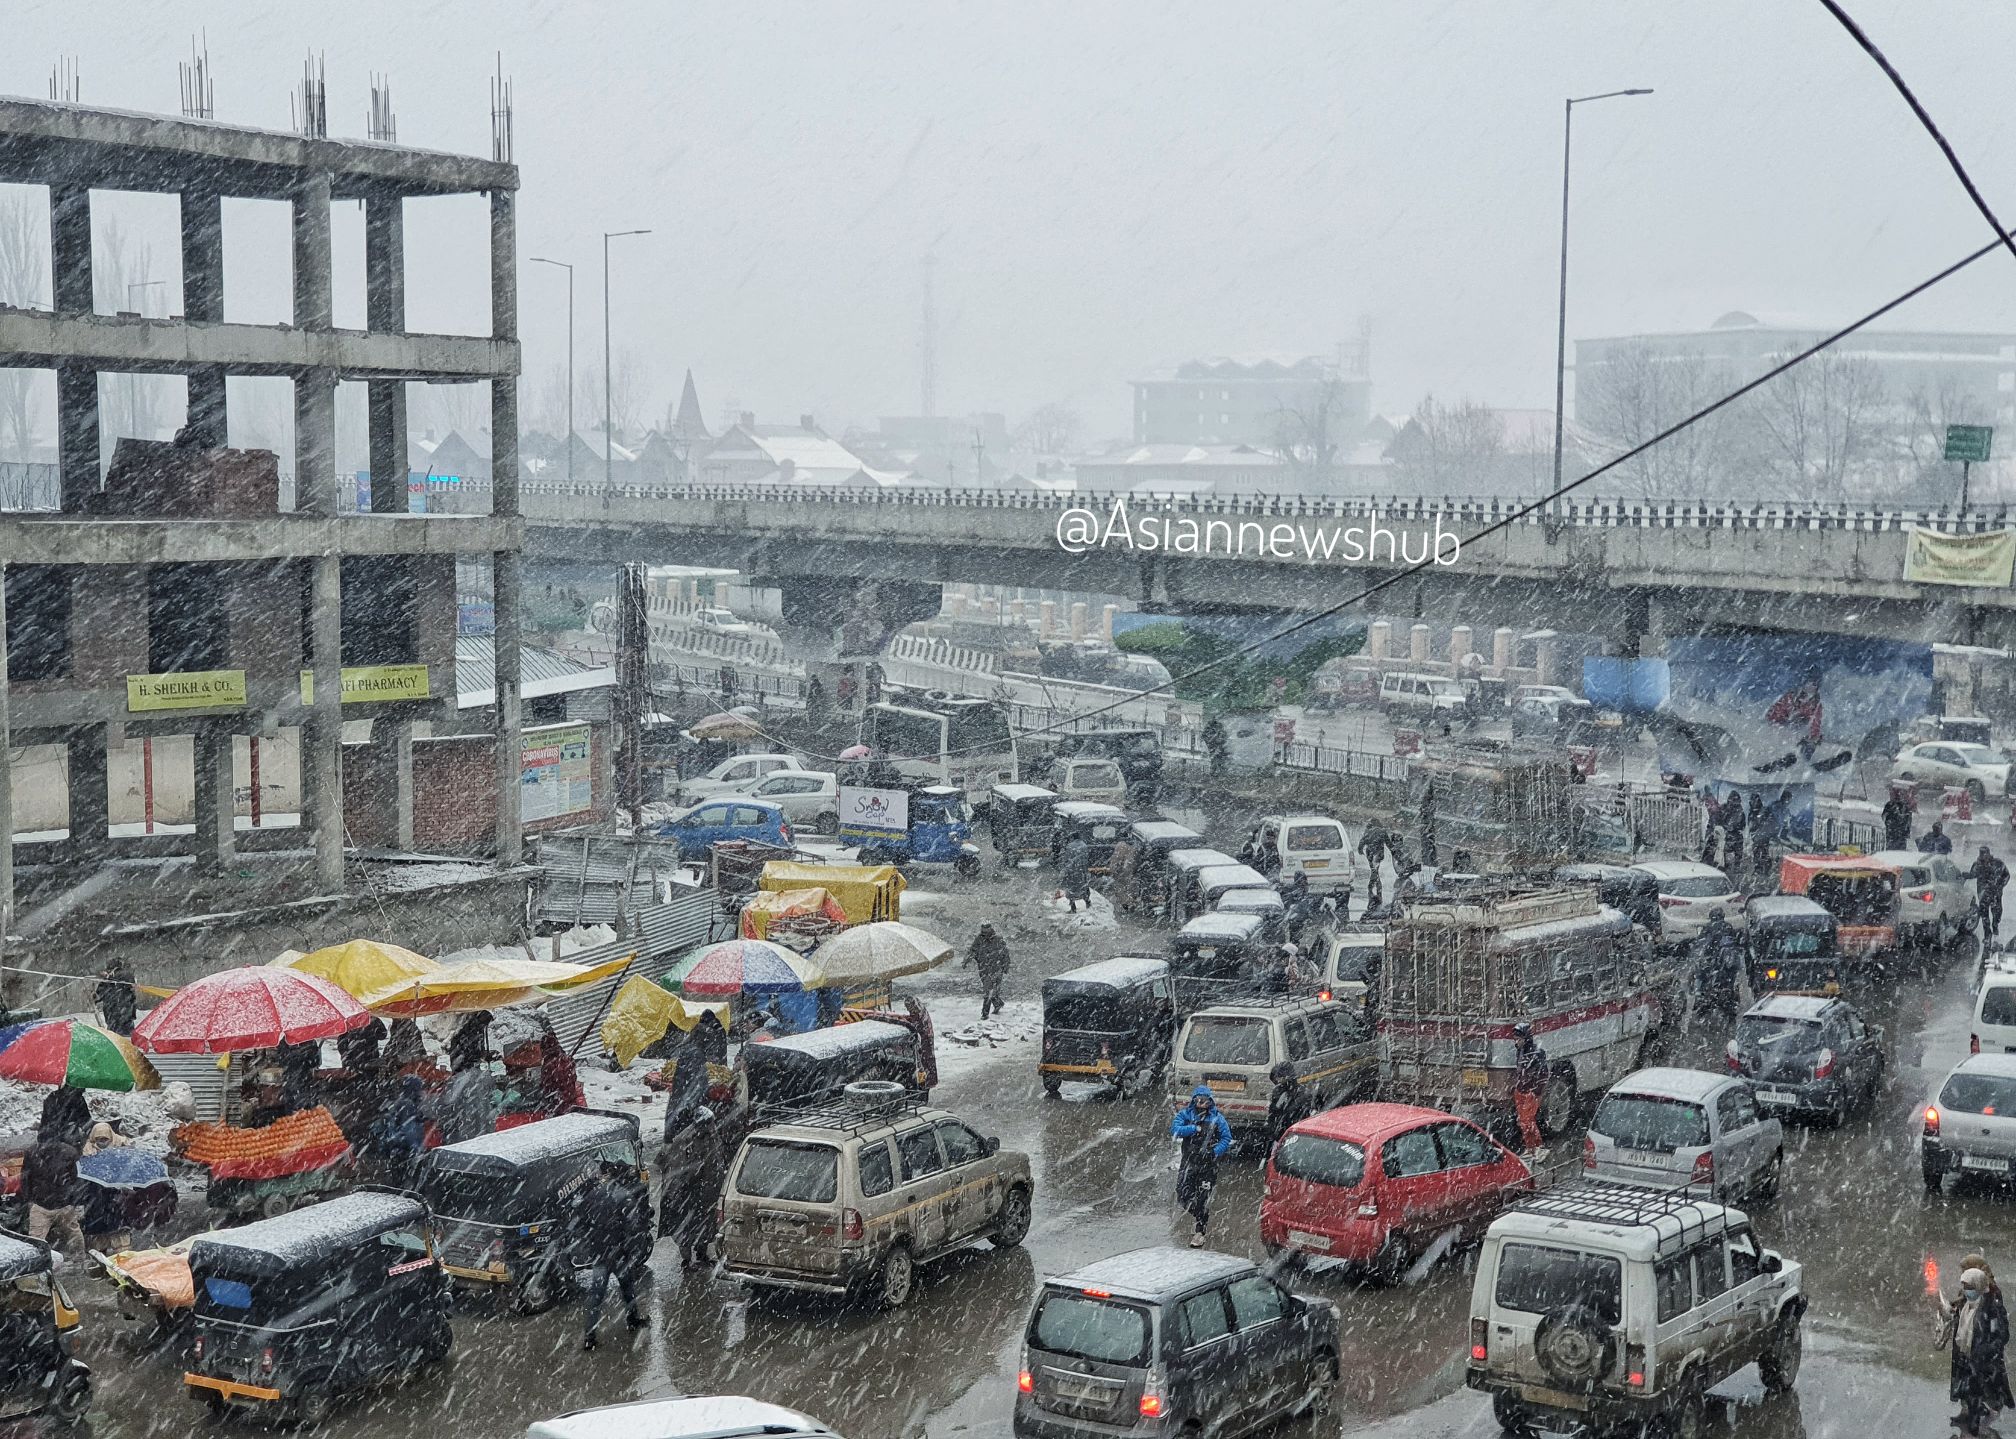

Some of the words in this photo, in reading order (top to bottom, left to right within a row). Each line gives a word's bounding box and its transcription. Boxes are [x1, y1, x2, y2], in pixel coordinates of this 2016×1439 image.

[139, 684, 151, 696] H.
[154, 681, 199, 696] SHEIKH
[201, 683, 211, 692] &
[214, 680, 233, 692] CO.
[358, 675, 418, 692] PHARMACY
